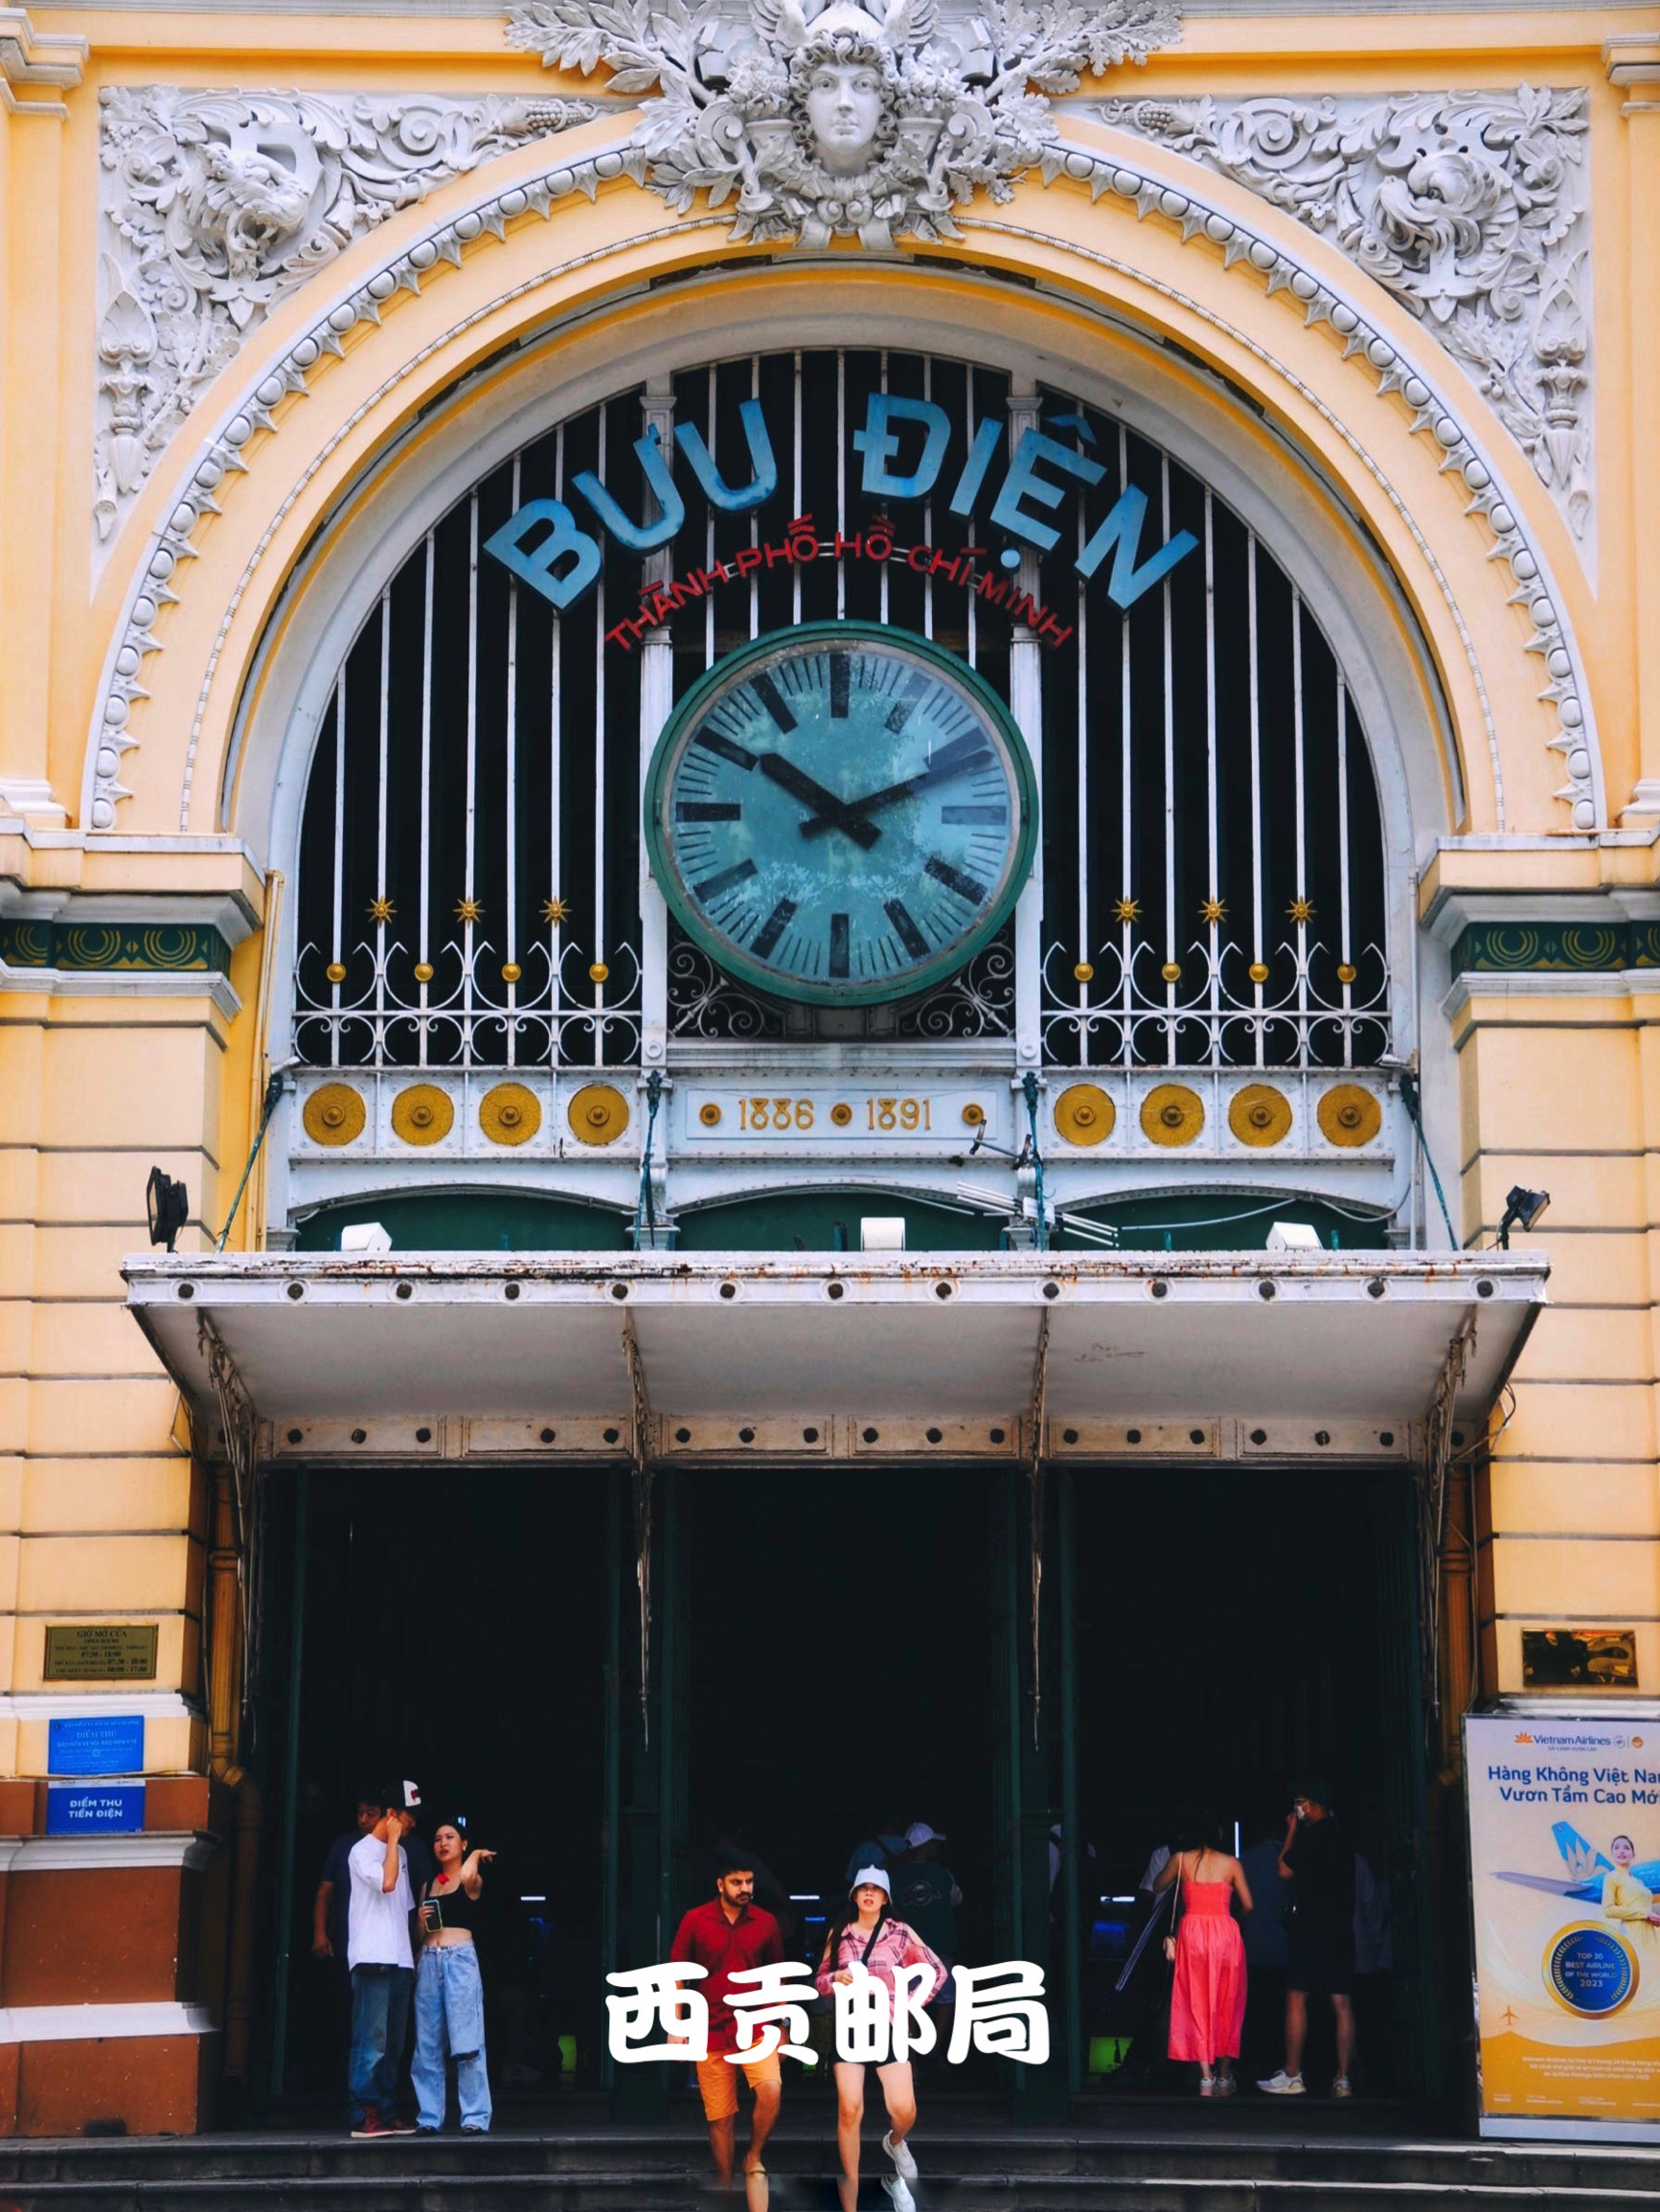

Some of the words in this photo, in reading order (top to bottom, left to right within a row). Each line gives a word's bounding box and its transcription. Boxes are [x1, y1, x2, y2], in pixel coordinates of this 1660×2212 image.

[483, 398, 778, 613] BƯU
[853, 392, 1200, 611] ĐIỆN
[977, 570, 1074, 649] MINH
[739, 1098, 815, 1130] 1886
[867, 1098, 932, 1130] 1891
[1534, 1735, 1574, 1745] Vietnam
[1575, 1735, 1611, 1745] Airlines
[1489, 1766, 1532, 1785] Hàng
[1536, 1767, 1589, 1786] Không
[1593, 1767, 1629, 1786] Việt
[1634, 1769, 1660, 1783] Na
[1500, 1787, 1547, 1802] Vươn
[1552, 1785, 1588, 1803] Tầm
[1594, 1788, 1626, 1804] Cao
